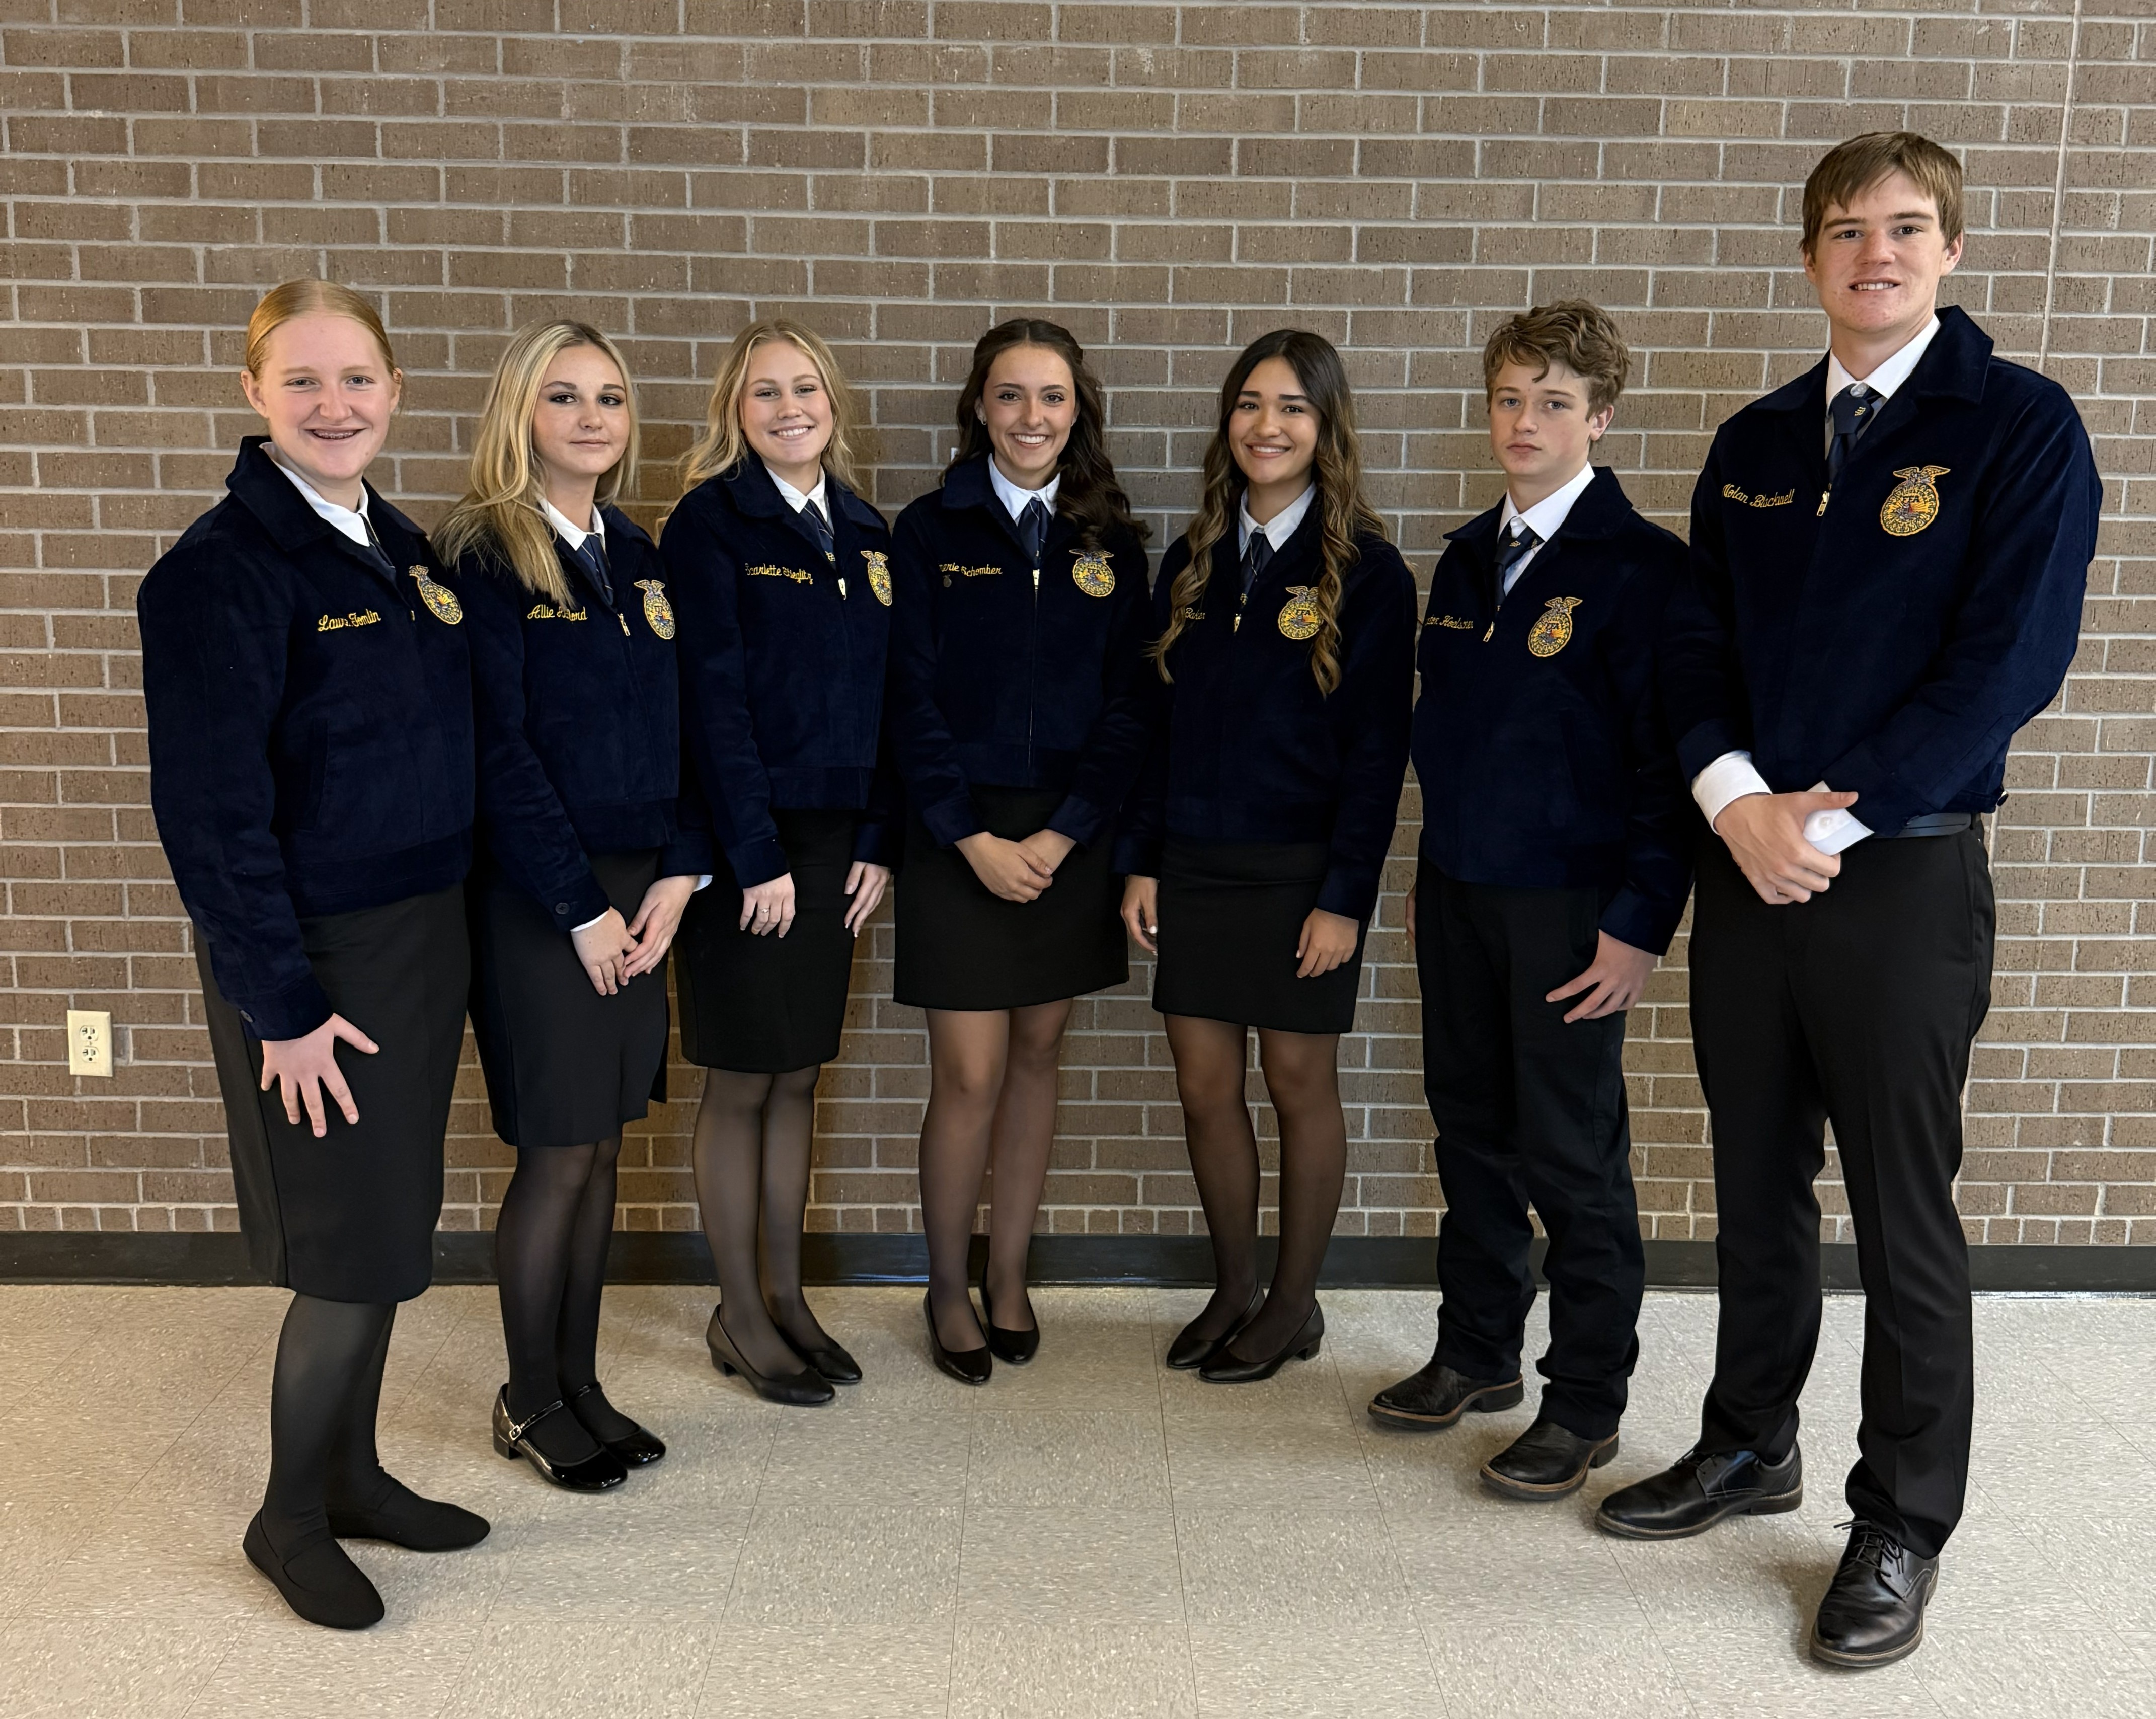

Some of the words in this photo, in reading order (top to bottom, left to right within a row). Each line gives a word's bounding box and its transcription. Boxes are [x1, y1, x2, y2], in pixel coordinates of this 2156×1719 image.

[1721, 483, 1747, 504] Nolan
[745, 563, 782, 576] Scarlette
[348, 608, 381, 627] Tomlin
[527, 604, 555, 619] Allie
